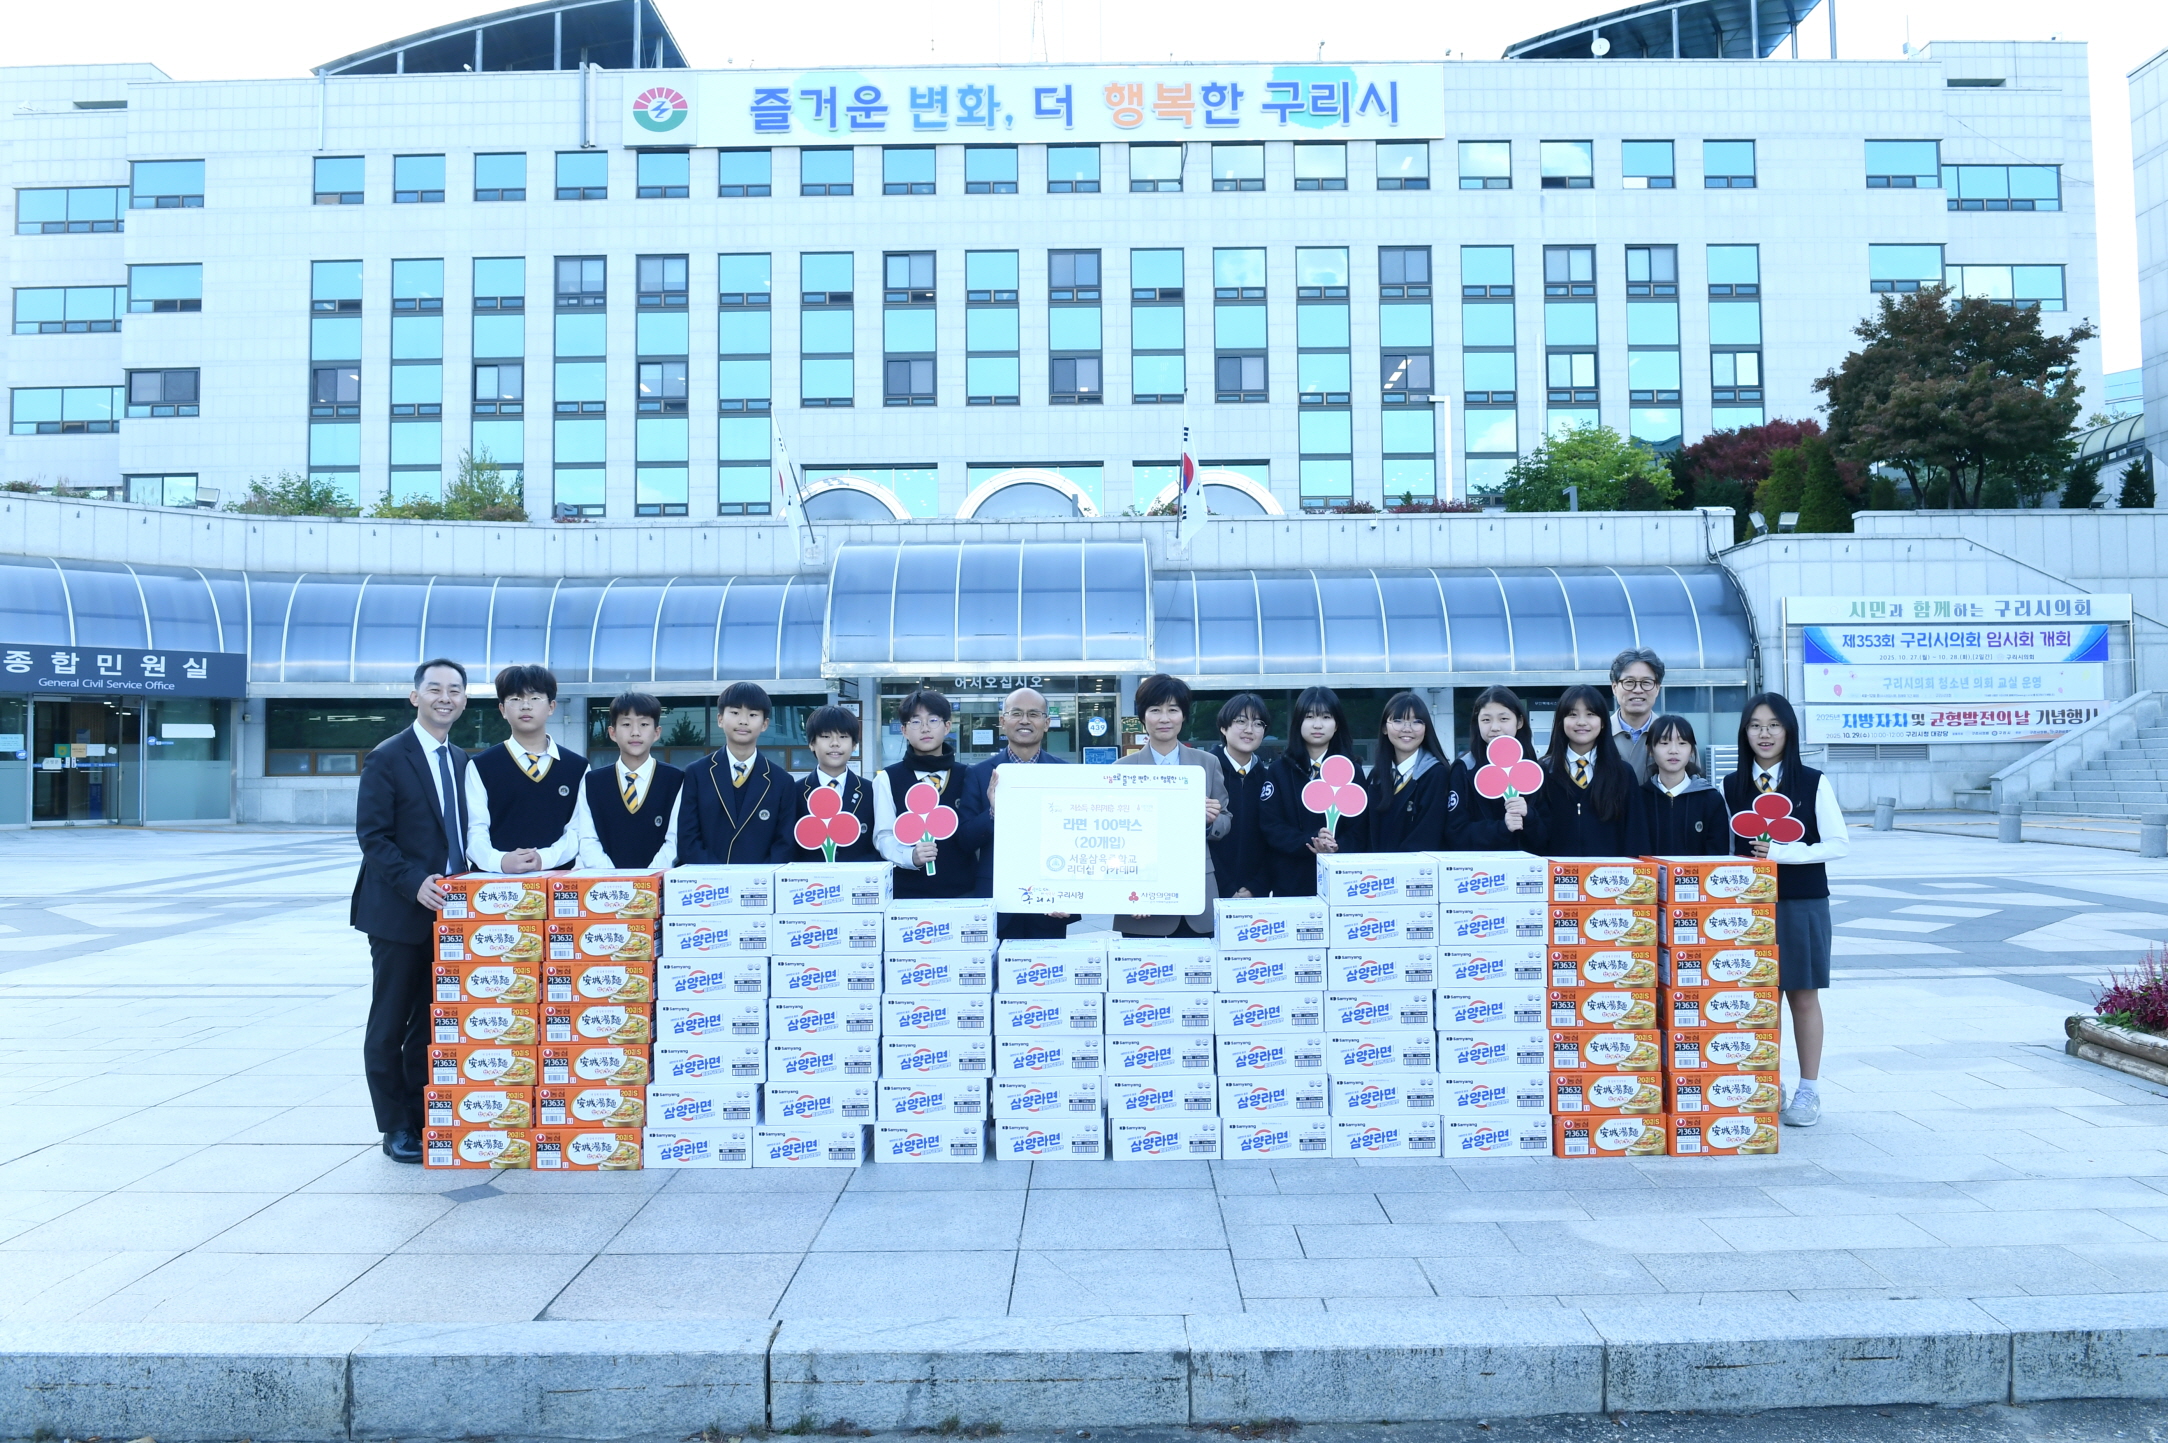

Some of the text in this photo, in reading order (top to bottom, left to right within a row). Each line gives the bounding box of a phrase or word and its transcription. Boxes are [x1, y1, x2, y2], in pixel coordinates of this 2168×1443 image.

[748, 79, 1400, 133] 즐거운 변화, 더 행복한 구리시
[1848, 598, 2092, 619] 시민과 함께하는 구리시의회
[1842, 630, 2071, 648] 제353회 구리시의회 임시회 개회
[3, 650, 208, 679] 종합민원실
[38, 678, 175, 690] General Civil Service Office
[954, 676, 1043, 689] 어서오십시오
[1883, 676, 2042, 690] 구리시의회 청소년 의회 교실 운영
[1842, 713, 1908, 728] 지방자치
[1911, 713, 1925, 726] 및
[1260, 785, 1272, 797] 25
[1063, 818, 1142, 832] 라면 100박스
[1074, 836, 1126, 849] (20개입)
[1067, 864, 1095, 875] 리더십
[1346, 877, 1394, 897] 삼양라면
[1457, 873, 1505, 893] 삼양라면
[1554, 876, 1578, 884] 가3632
[443, 893, 467, 901] 가3632
[681, 886, 729, 906] 삼양라면
[792, 885, 840, 905] 삼양라면
[902, 923, 950, 943] 삼양라면
[1237, 921, 1285, 941] 삼양라면
[1347, 919, 1395, 939] 삼양라면
[1457, 916, 1505, 936] 삼양라면
[439, 935, 463, 943] 가3632
[680, 929, 728, 949] 삼양라면
[790, 927, 838, 947] 삼양라면
[788, 969, 836, 989] 삼양라면
[900, 965, 948, 985] 삼양라면
[1015, 965, 1063, 985] 삼양라면
[1125, 964, 1173, 984] 삼양라면
[1235, 963, 1283, 983] 삼양라면
[1346, 962, 1394, 982] 삼양라면
[1455, 959, 1503, 979] 삼양라면
[436, 976, 460, 984] 가3632
[674, 972, 722, 992] 삼양라면
[546, 1016, 570, 1024] 가3632
[787, 1011, 835, 1031] 삼양라면
[898, 1007, 946, 1027] 삼양라면
[1011, 1007, 1059, 1027] 삼양라면
[1123, 1006, 1171, 1026] 삼양라면
[1232, 1006, 1280, 1026] 삼양라면
[1341, 1003, 1389, 1023] 삼양라면
[1455, 1002, 1503, 1022] 삼양라면
[673, 1014, 721, 1034] 삼양라면
[1123, 1047, 1171, 1067] 삼양라면
[1235, 1047, 1283, 1067] 삼양라면
[1344, 1045, 1392, 1065] 삼양라면
[1457, 1044, 1505, 1064] 삼양라면
[1675, 1043, 1699, 1051] 가3632
[672, 1056, 720, 1076] 삼양라면
[785, 1053, 833, 1073] 삼양라면
[900, 1050, 948, 1070] 삼양라면
[1013, 1049, 1061, 1069] 삼양라면
[1010, 1090, 1058, 1110] 삼양라면
[1125, 1090, 1173, 1110] 삼양라면
[1237, 1089, 1285, 1109] 삼양라면
[1348, 1087, 1396, 1107] 삼양라면
[1457, 1087, 1505, 1107] 삼양라면
[1677, 1086, 1701, 1094] 가3632
[664, 1099, 712, 1119] 삼양라면
[783, 1096, 831, 1116] 삼양라면
[895, 1093, 943, 1113] 삼양라면
[1130, 1132, 1178, 1152] 삼양라면
[1240, 1131, 1288, 1151] 삼양라면
[1350, 1129, 1398, 1149] 삼양라면
[1461, 1129, 1509, 1149] 삼양라면
[1677, 1128, 1701, 1136] 가3632
[660, 1140, 708, 1160] 삼양라면
[769, 1139, 817, 1159] 삼양라면
[891, 1135, 939, 1155] 삼양라면
[1012, 1133, 1060, 1153] 삼양라면
